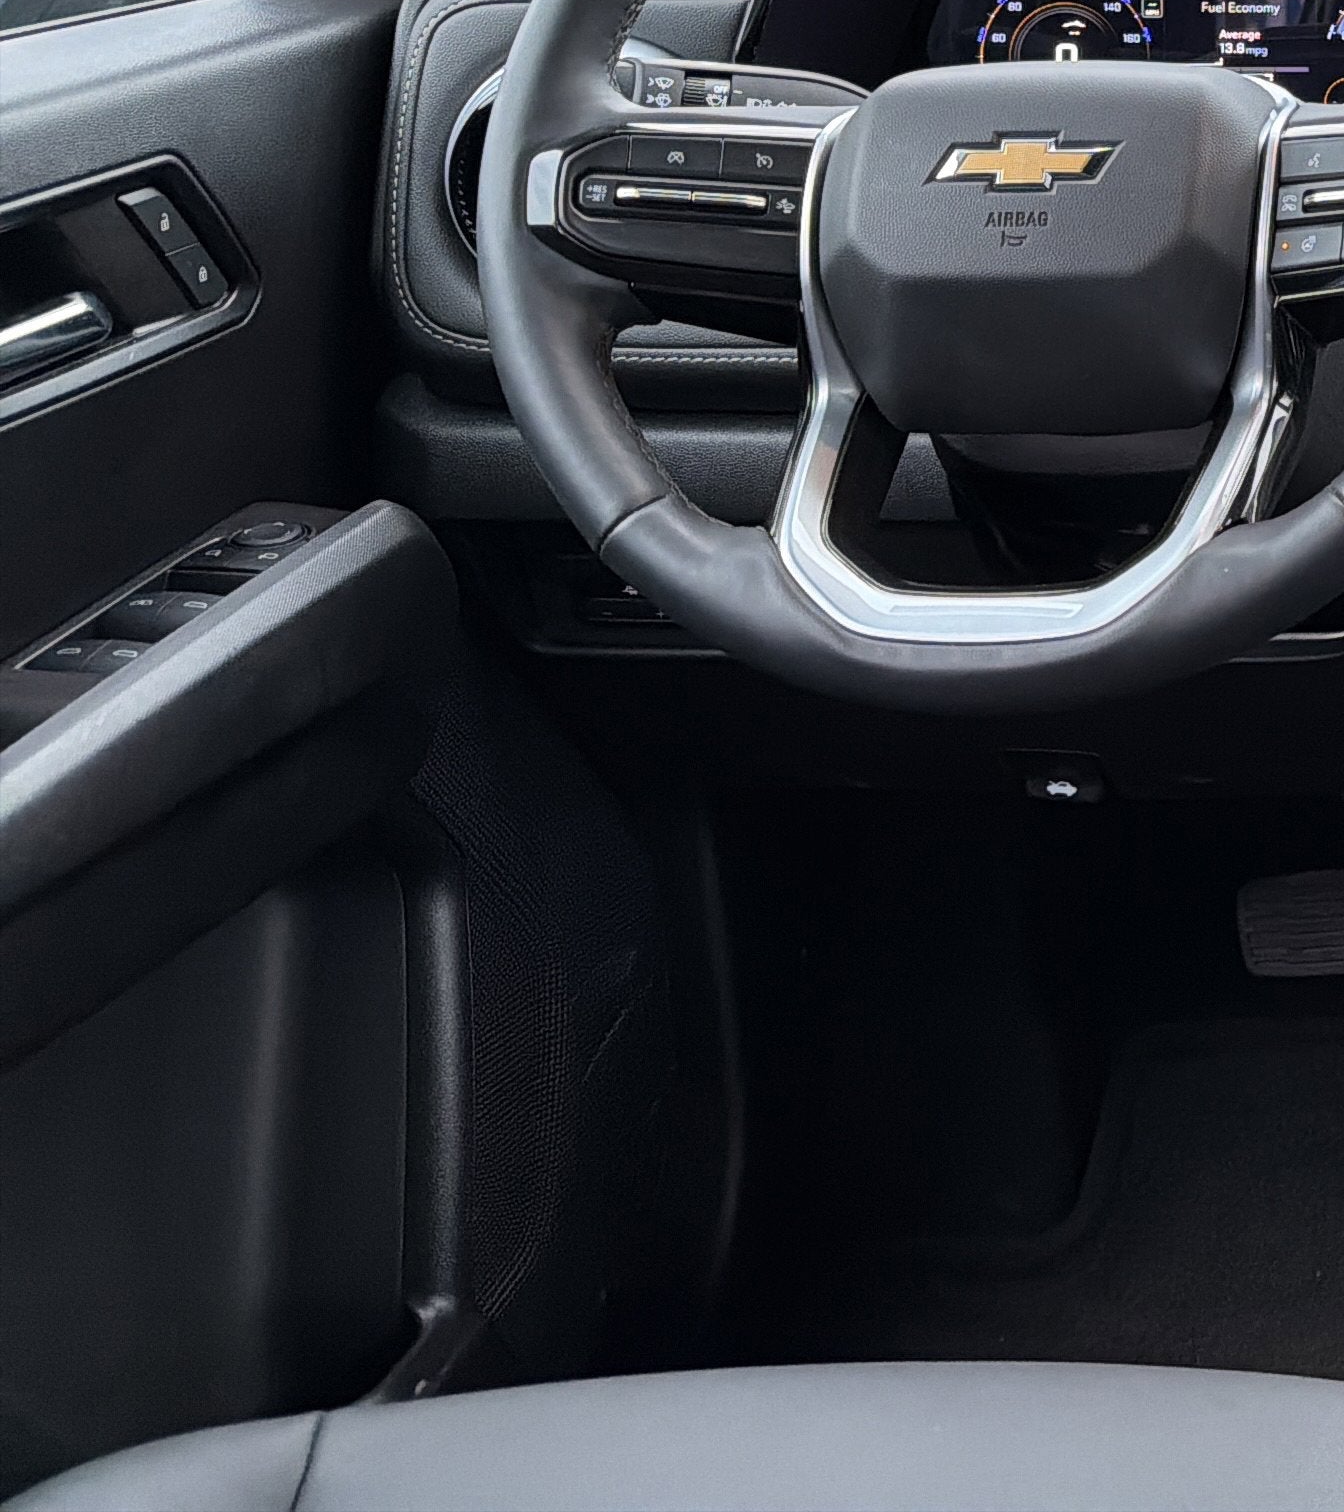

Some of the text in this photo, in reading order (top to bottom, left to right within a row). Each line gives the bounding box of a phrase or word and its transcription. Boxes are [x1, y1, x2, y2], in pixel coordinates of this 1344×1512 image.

[1103, 2, 1122, 13] 140
[1200, 1, 1281, 16] Fuel Economy
[991, 33, 1007, 43] 60
[1218, 29, 1262, 42] Average
[984, 210, 1049, 228] AIRBAG
